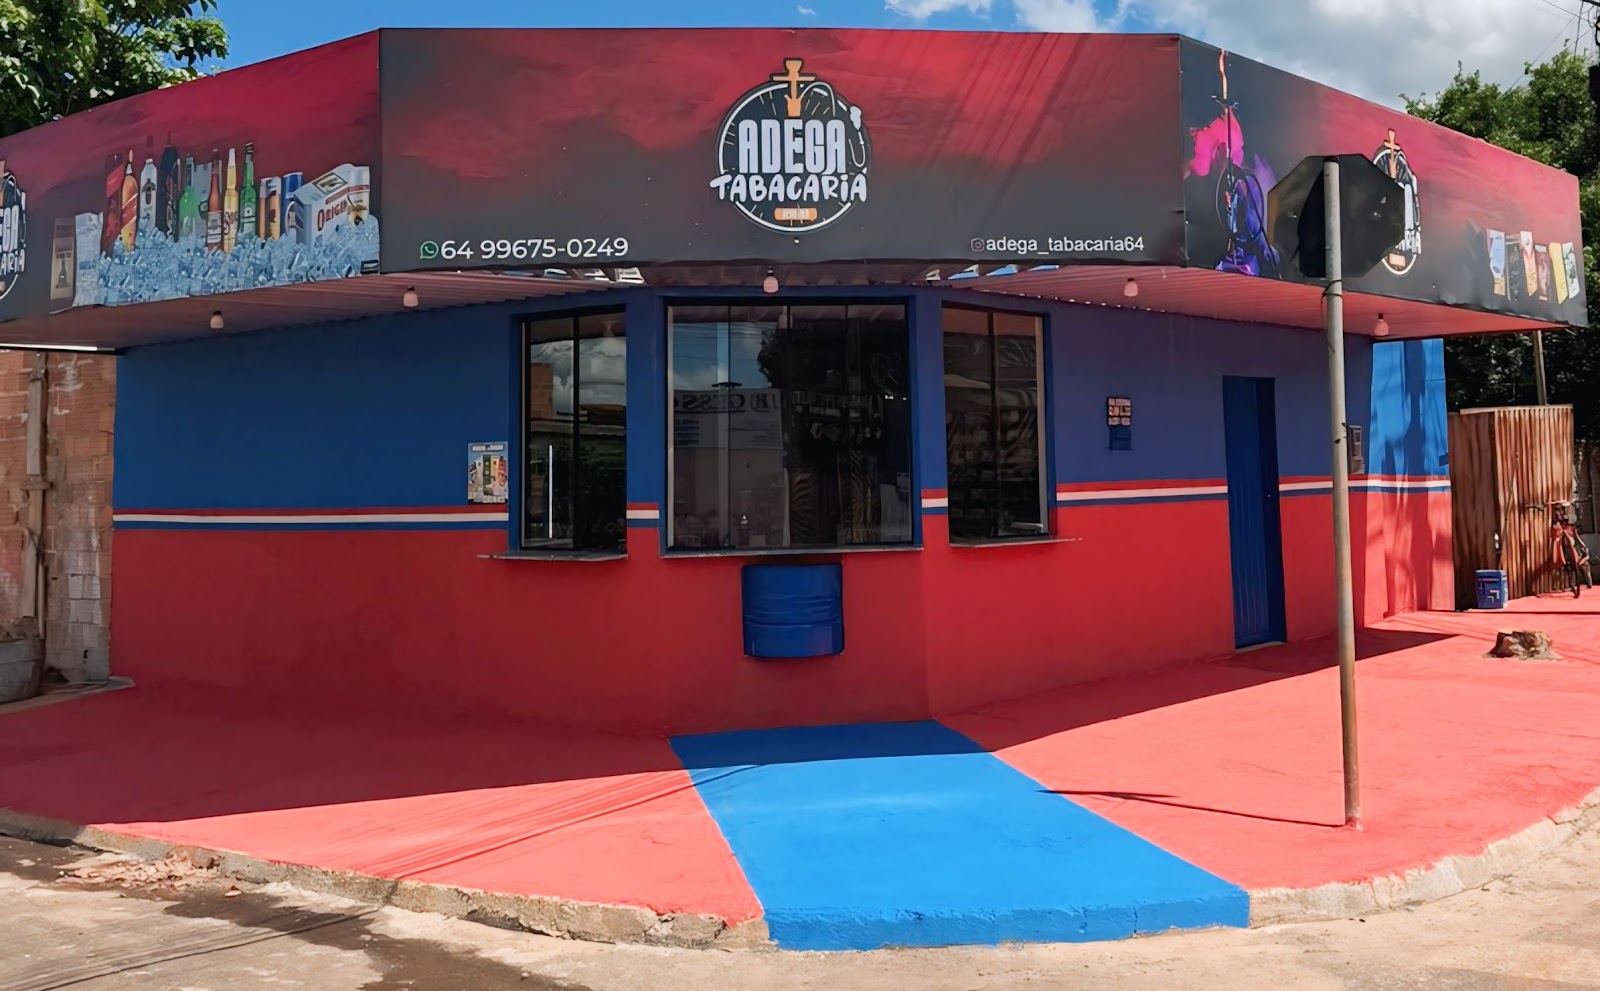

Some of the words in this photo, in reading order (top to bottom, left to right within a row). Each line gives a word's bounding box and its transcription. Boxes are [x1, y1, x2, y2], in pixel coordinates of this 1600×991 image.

[738, 119, 847, 175] ADEGA
[441, 240, 474, 259] 64
[480, 237, 629, 259] 99675-0249
